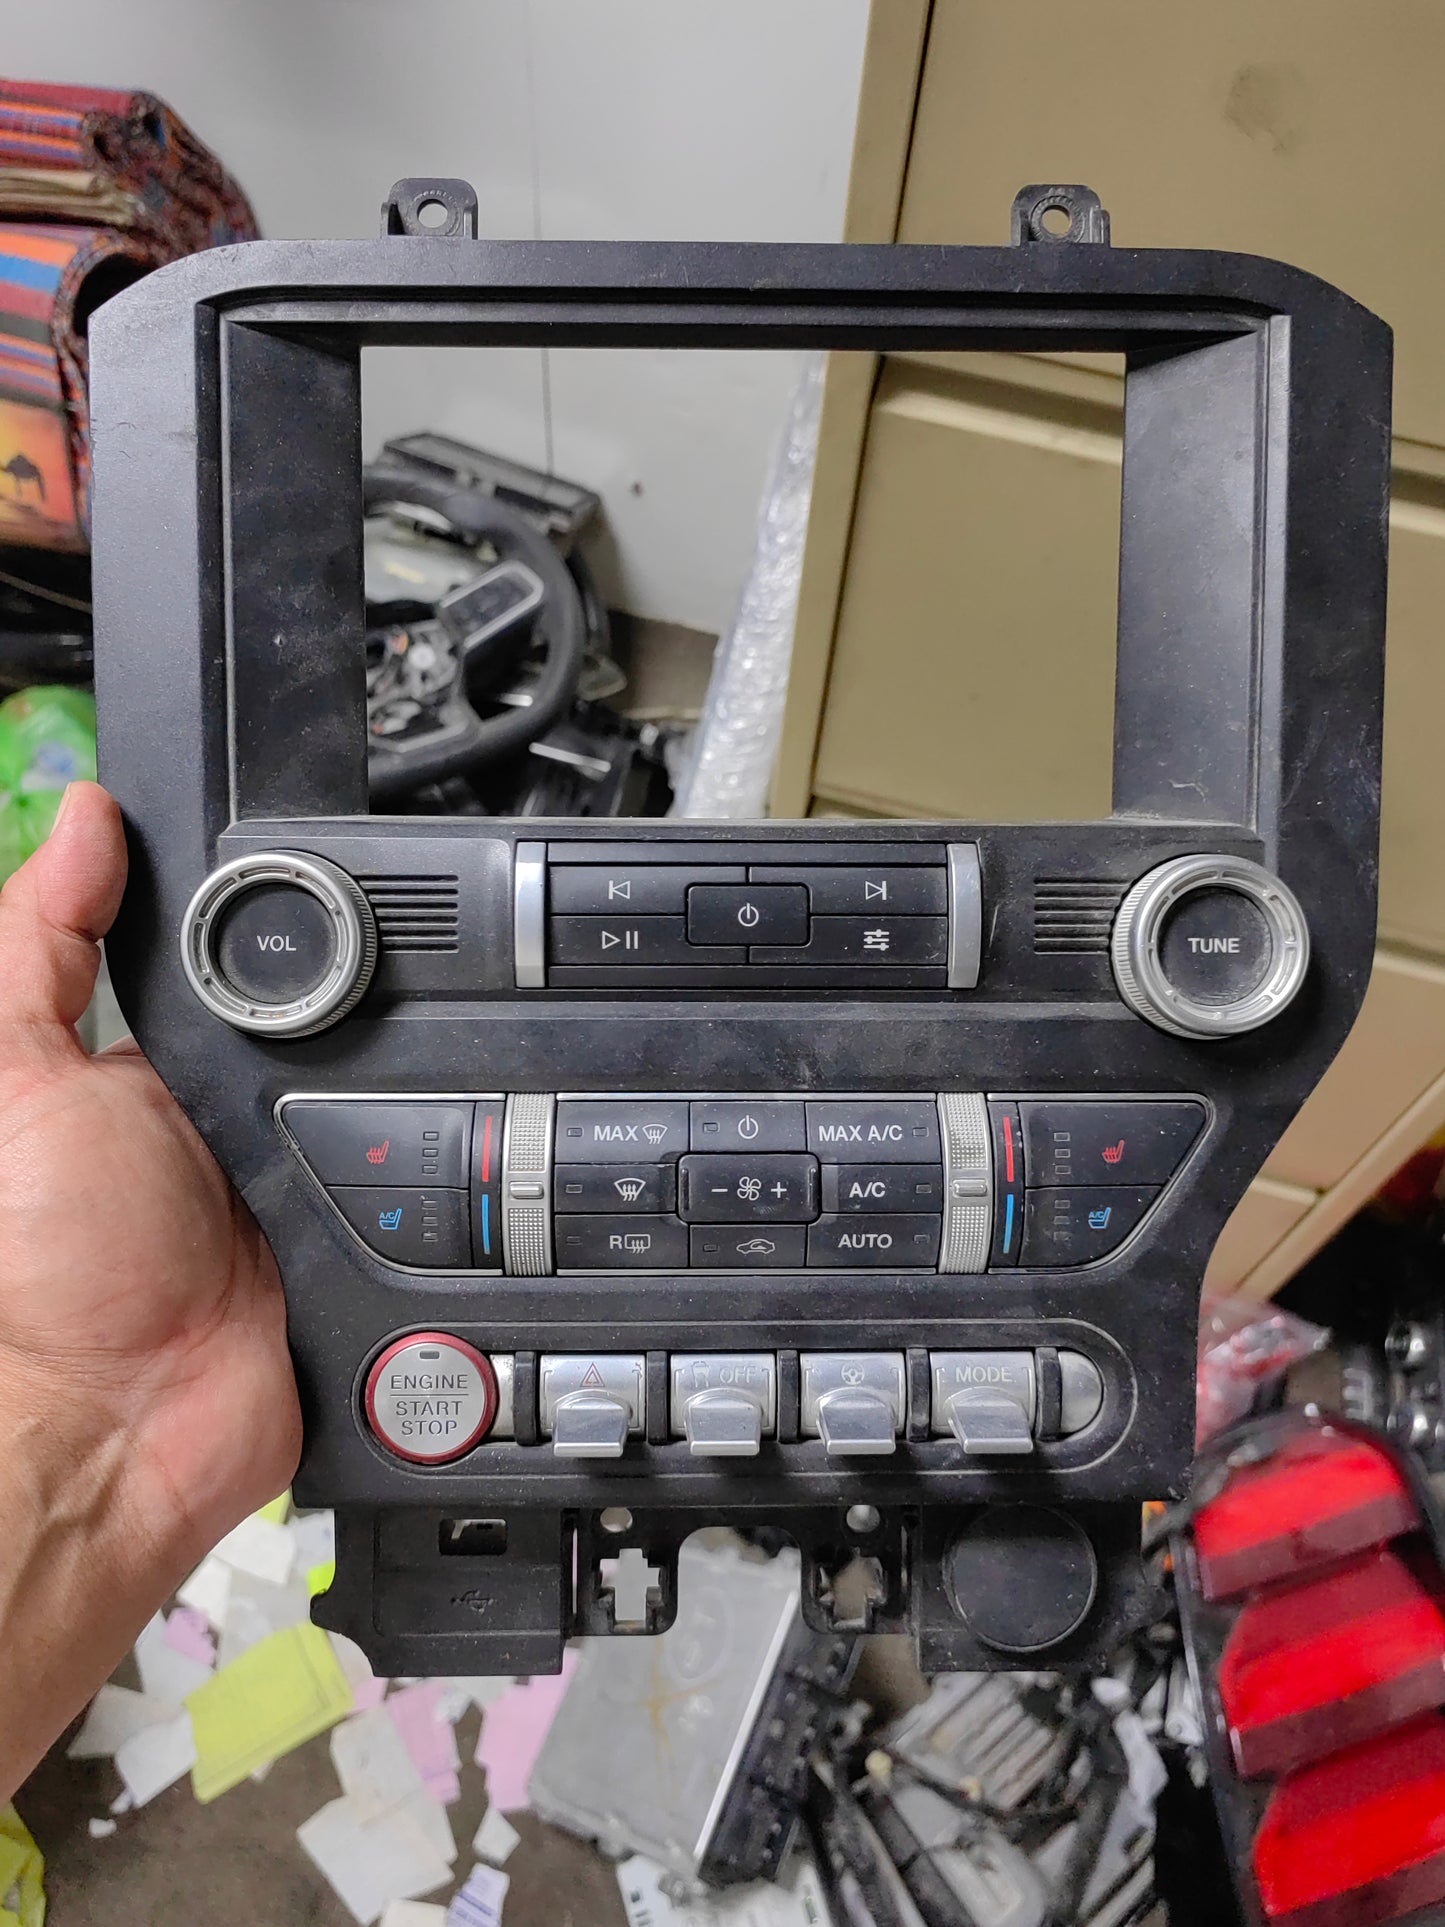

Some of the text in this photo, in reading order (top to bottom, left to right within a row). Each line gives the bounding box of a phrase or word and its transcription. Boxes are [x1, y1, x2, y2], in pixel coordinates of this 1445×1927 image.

[256, 935, 297, 952] VOL
[1187, 937, 1240, 954] TUNE
[593, 1125, 639, 1142] MAX
[818, 1124, 903, 1142] MAX A/C
[849, 1182, 886, 1198] A/C
[379, 1211, 395, 1220] A/C
[609, 1235, 623, 1250] R
[838, 1233, 893, 1249] AUTO
[390, 1374, 468, 1390] ENGINE
[719, 1366, 758, 1384] OFF
[955, 1366, 1013, 1384] MODE
[395, 1401, 463, 1416] START
[401, 1420, 457, 1436] STOP
